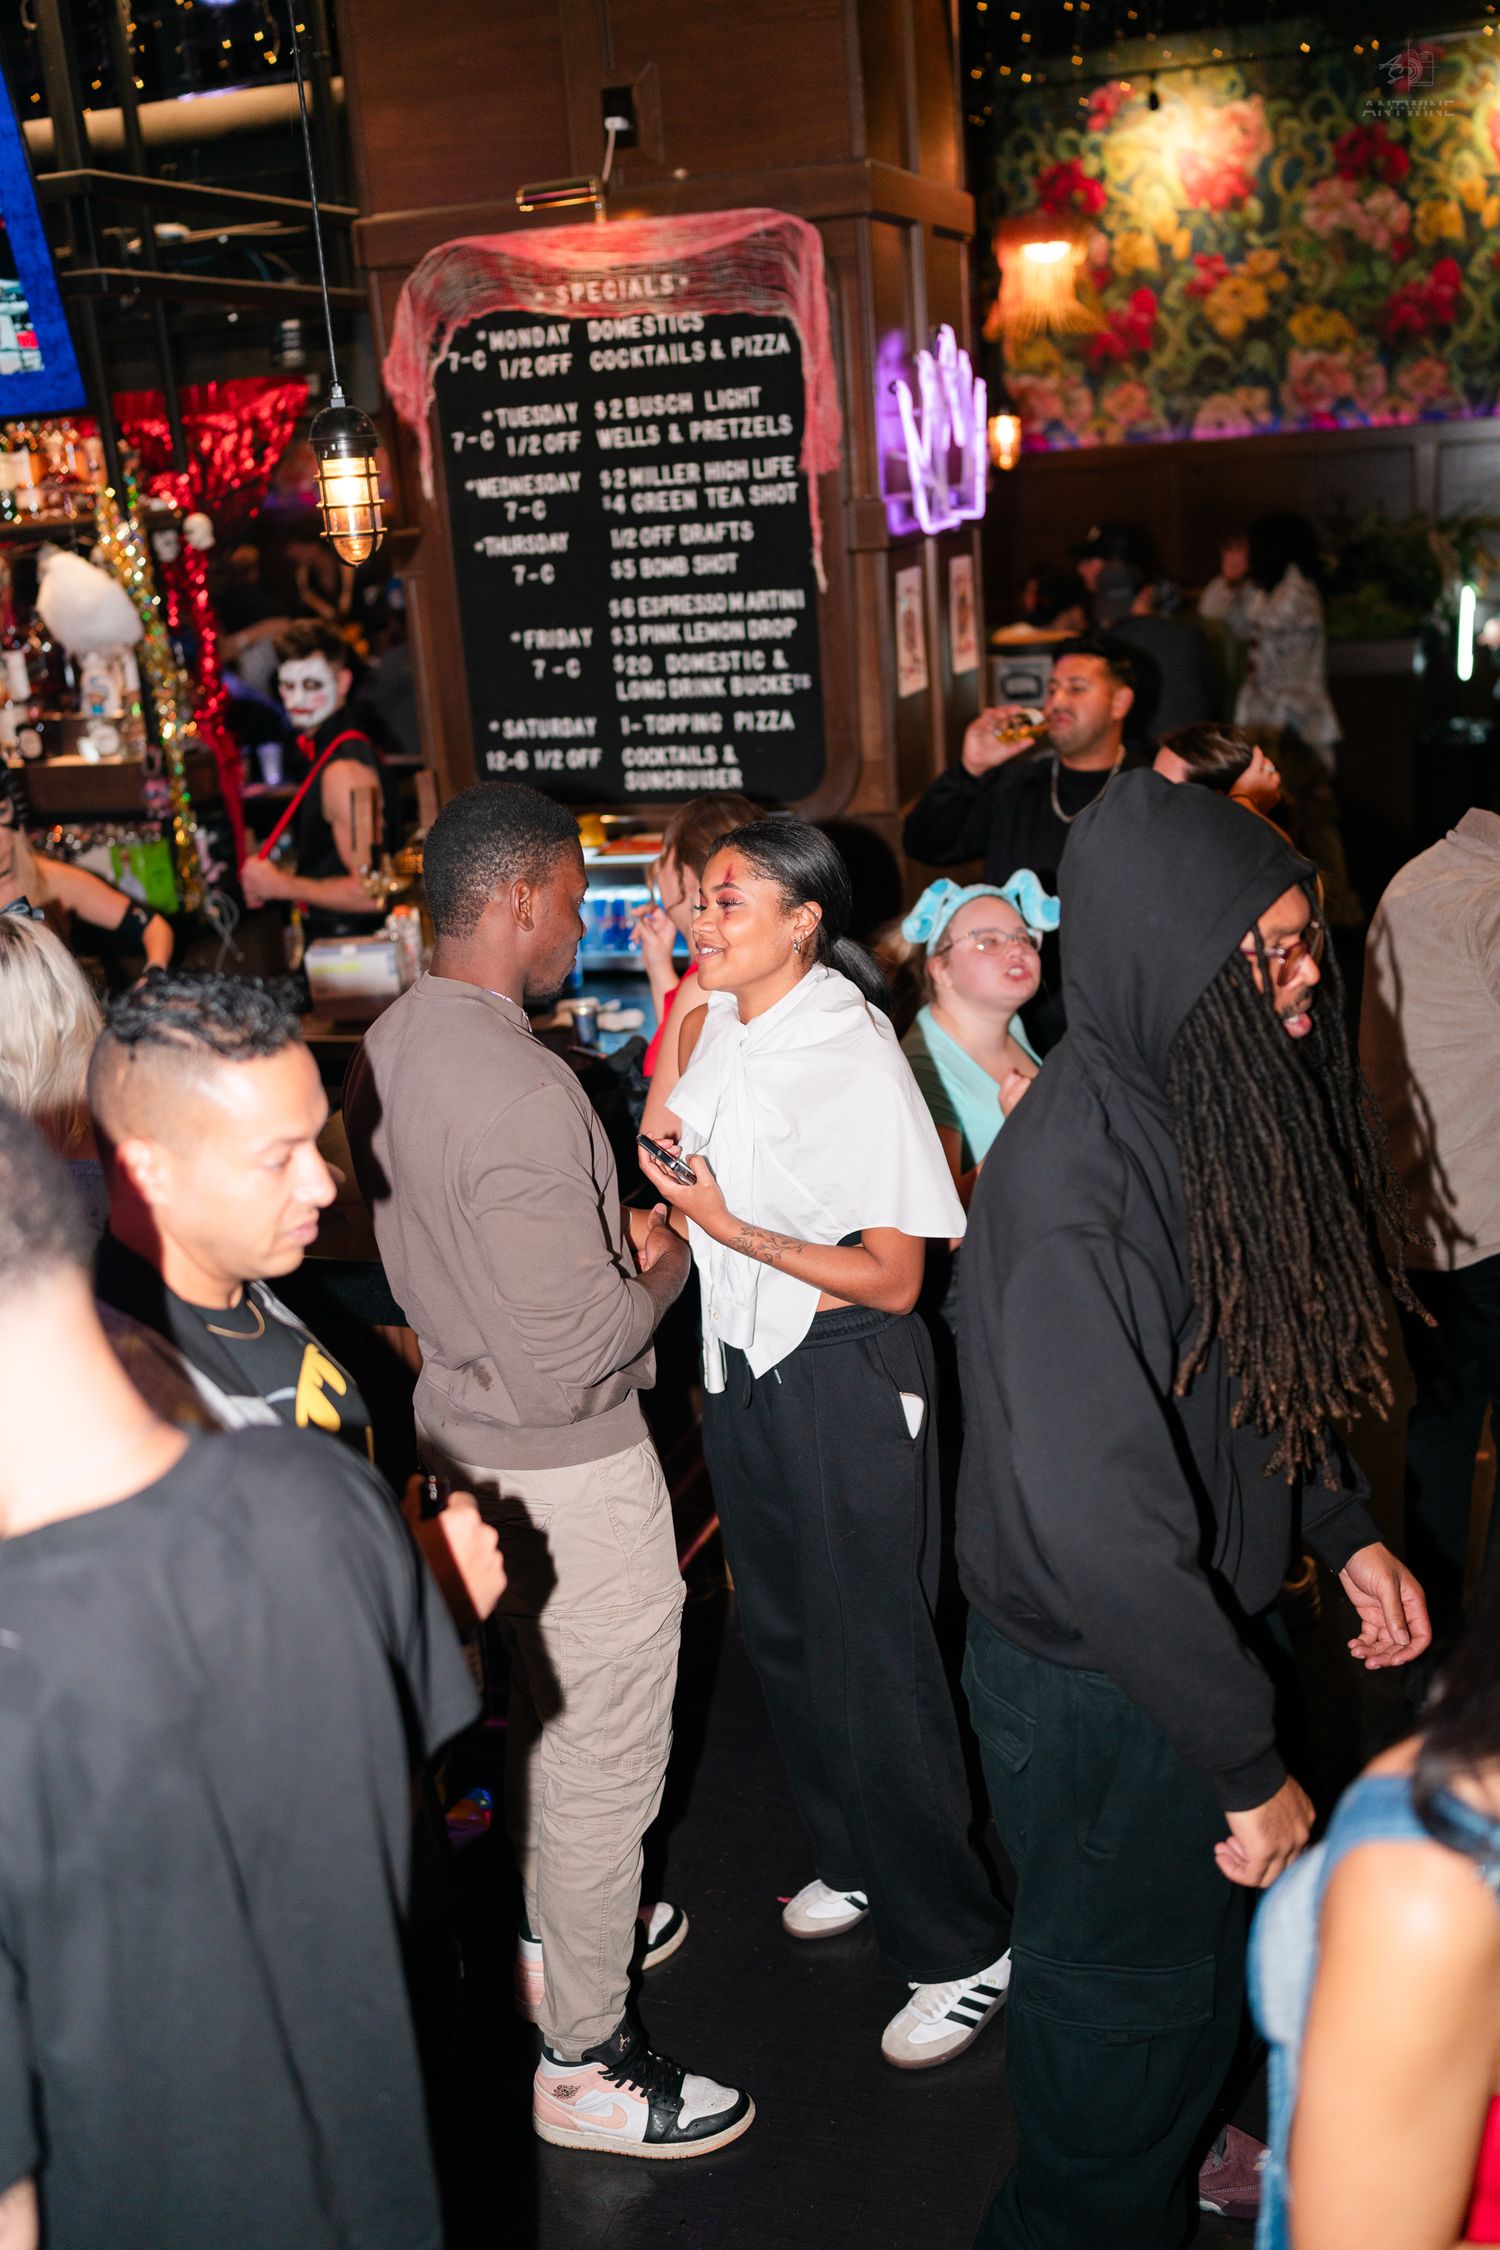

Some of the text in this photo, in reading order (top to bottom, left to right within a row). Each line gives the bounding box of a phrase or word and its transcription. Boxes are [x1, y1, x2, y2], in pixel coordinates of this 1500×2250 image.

[556, 273, 674, 304] SPECIALS
[534, 353, 572, 376] OFF
[590, 333, 790, 372] COCKTAILS & PIZZA
[495, 402, 578, 428] TUESDAY
[594, 386, 761, 420] $2 BUSCH LIGHT
[543, 431, 581, 454] OFF
[596, 414, 793, 449] WELLS & PRETZELS
[475, 472, 581, 498] WEDNESDAY
[600, 468, 626, 489] $2
[704, 460, 749, 482] HIGH
[752, 455, 795, 479] LIFE
[631, 490, 697, 513] GREEN
[704, 487, 745, 508] TEA
[749, 482, 798, 506] SHOT
[482, 532, 569, 556] THURSDAY
[639, 525, 675, 547] OFF
[679, 521, 754, 545] DRAFTS
[611, 552, 739, 579] $5 BOMB SHOT
[637, 593, 728, 617] ESPRESSO
[523, 628, 592, 649] FRIDAY
[639, 624, 682, 644] PINK
[683, 621, 746, 643] LEMON
[747, 617, 797, 640] DROP
[613, 654, 653, 676] $20
[773, 649, 788, 669] &
[616, 679, 666, 701] LONG
[668, 677, 726, 699] DRINK
[503, 717, 597, 739] SATURDAY
[734, 710, 795, 732] PIZZA
[566, 748, 602, 769] OFF
[622, 744, 738, 768] COCKTAILS &
